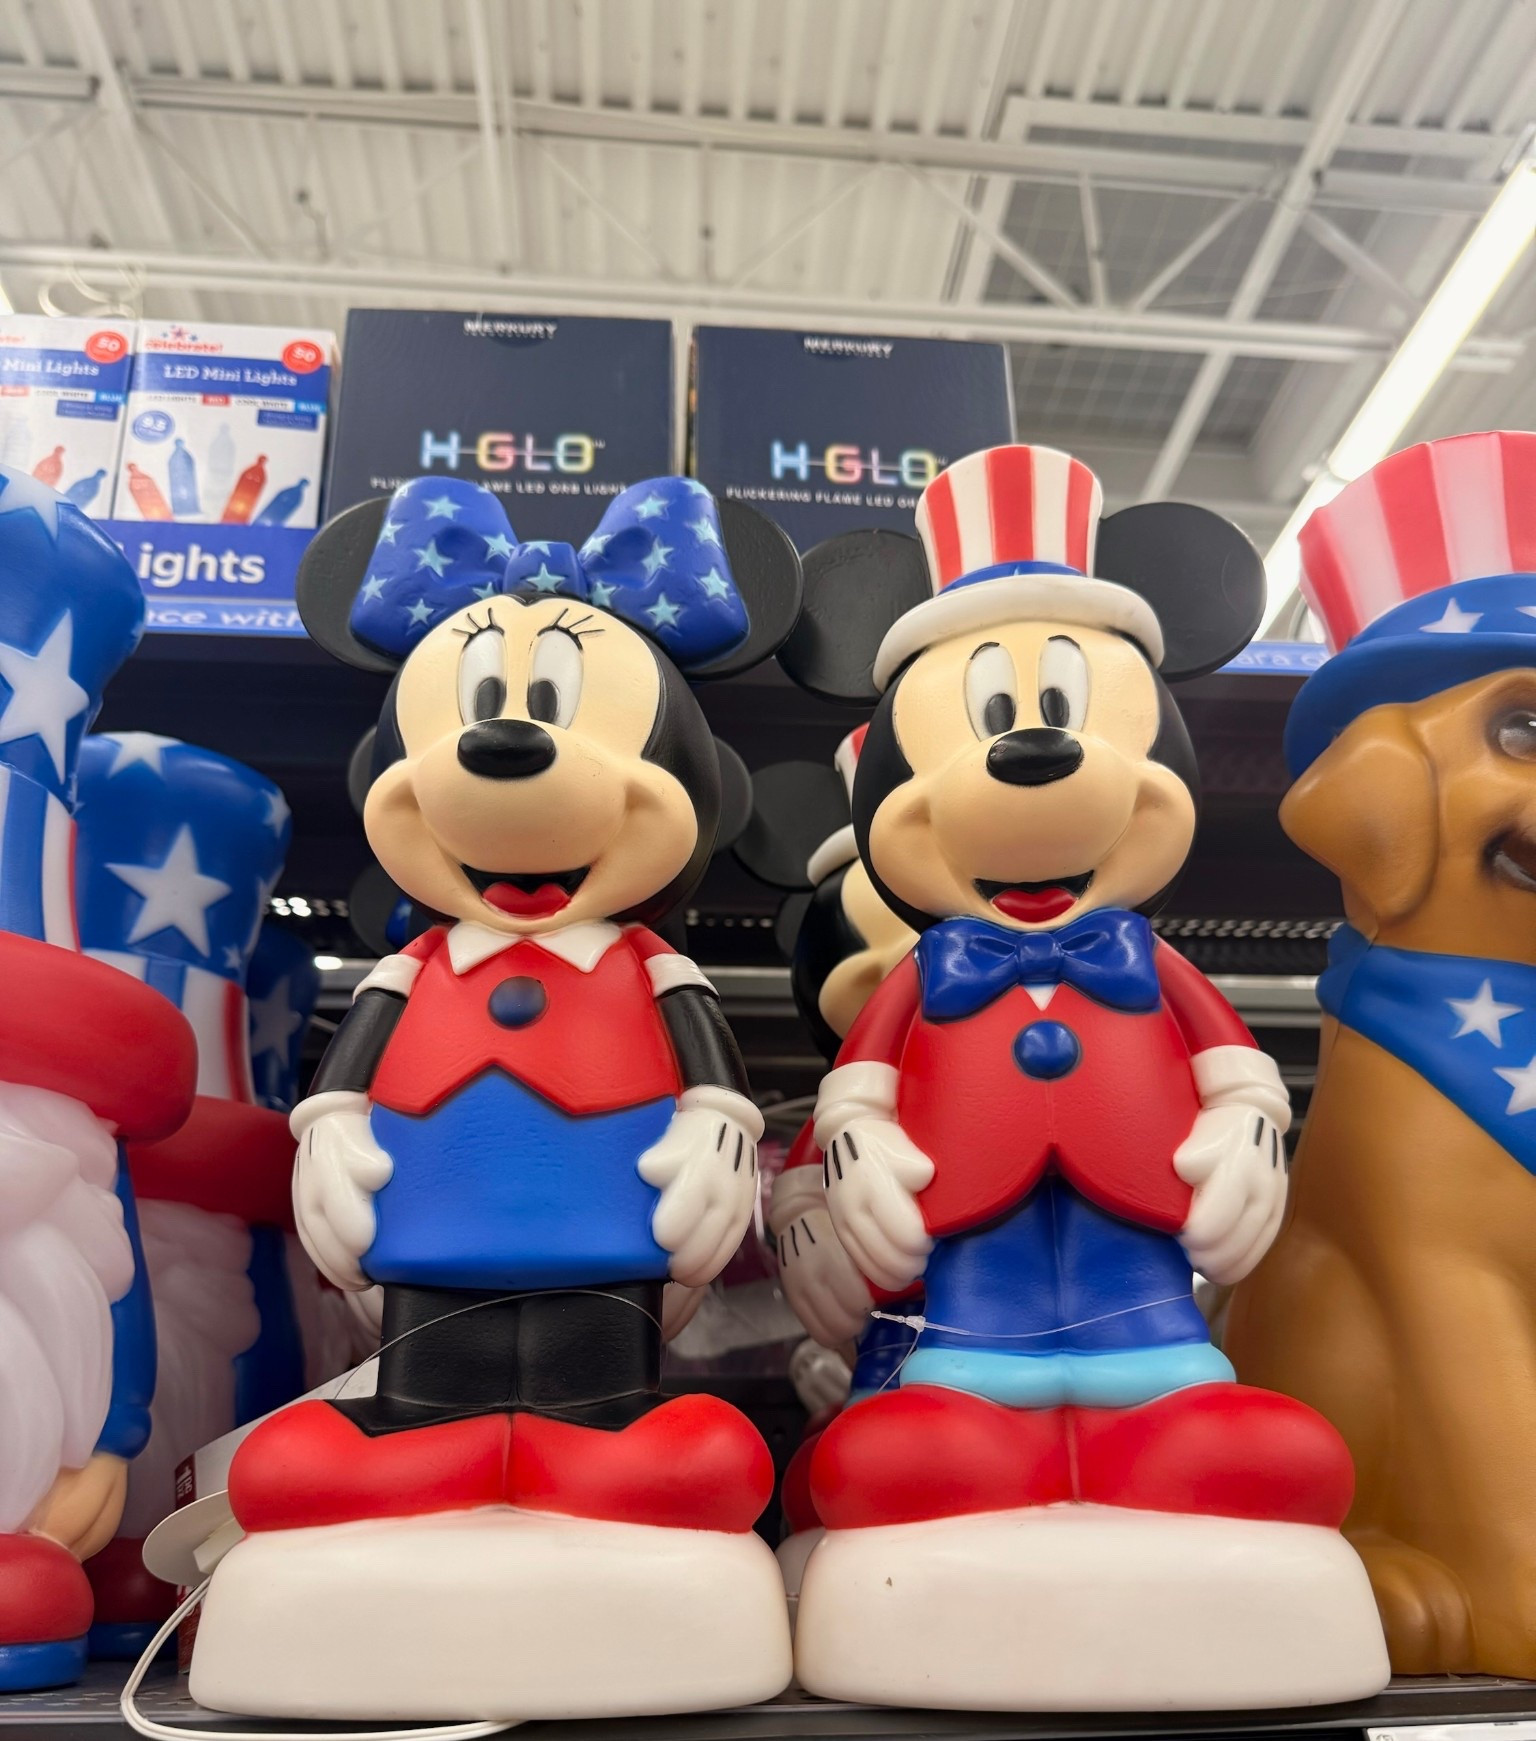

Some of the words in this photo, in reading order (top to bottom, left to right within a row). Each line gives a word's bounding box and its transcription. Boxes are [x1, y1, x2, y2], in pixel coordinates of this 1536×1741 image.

[98, 337, 120, 352] 50
[293, 346, 316, 362] 50
[2, 358, 41, 372] Mini
[45, 359, 99, 377] Lights
[164, 366, 198, 379] LED
[203, 367, 240, 382] Mini
[245, 368, 297, 387] Lights
[725, 485, 812, 503] FLICKERING
[815, 489, 862, 506] FLAME
[865, 494, 894, 508] LED
[137, 541, 265, 589] ights
